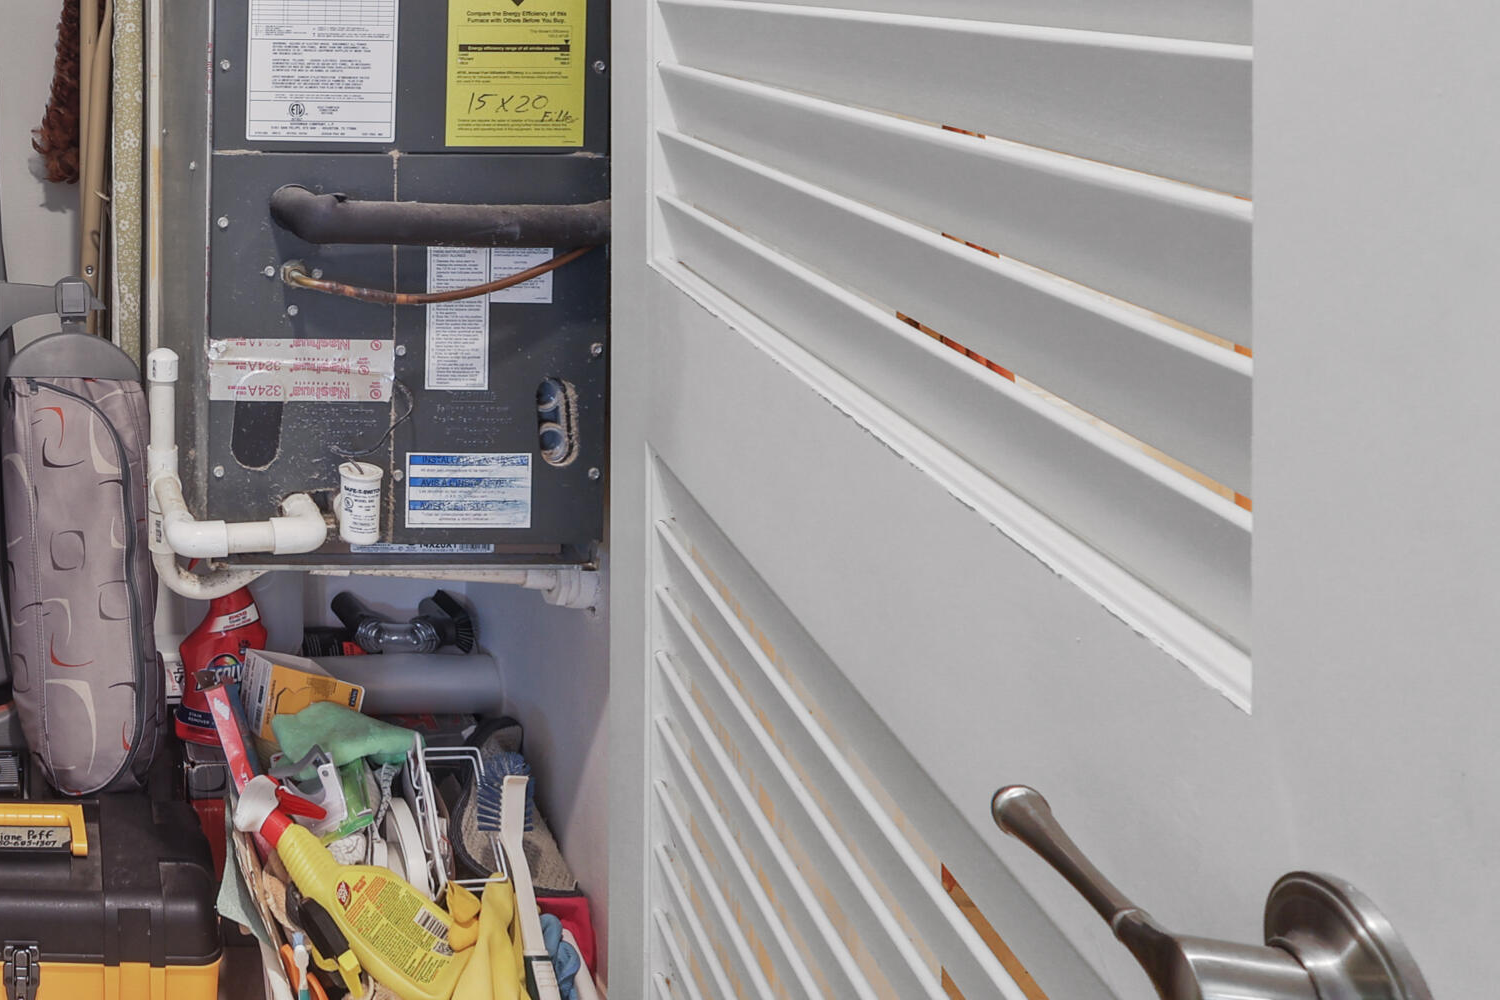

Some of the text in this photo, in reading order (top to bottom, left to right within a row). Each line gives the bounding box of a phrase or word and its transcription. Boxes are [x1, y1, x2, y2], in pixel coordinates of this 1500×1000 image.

[248, 362, 282, 371] 324A
[249, 385, 350, 399] Nashua 324A
